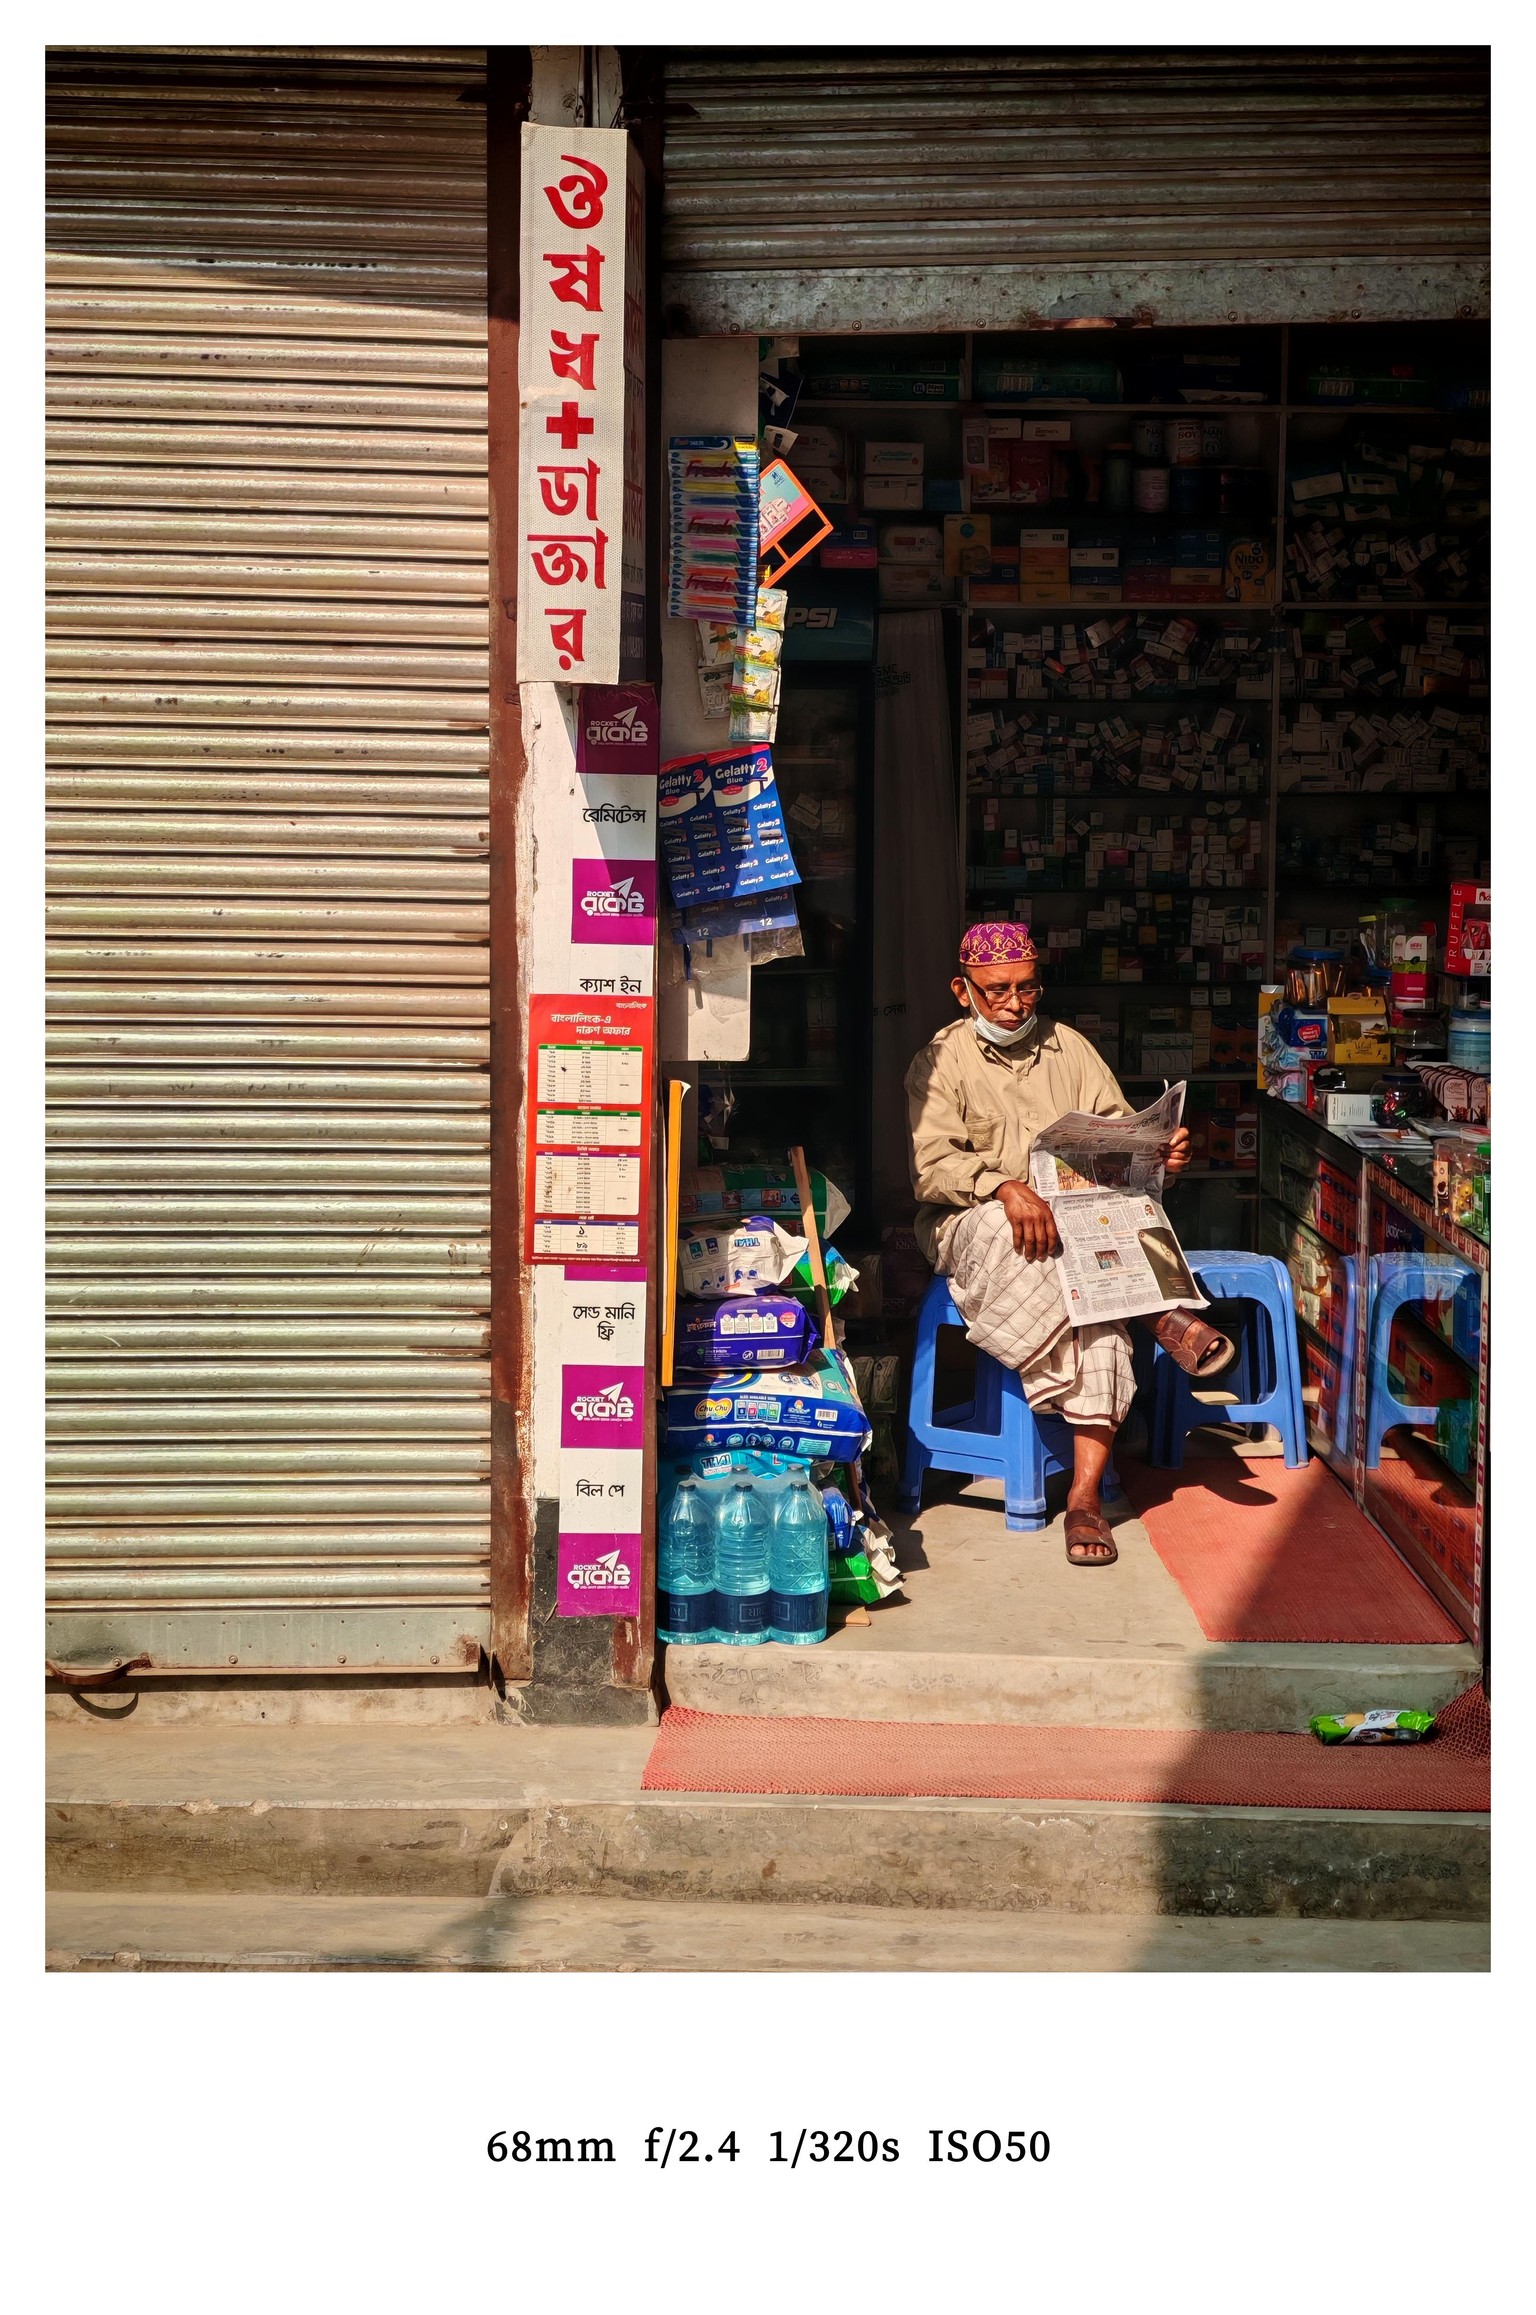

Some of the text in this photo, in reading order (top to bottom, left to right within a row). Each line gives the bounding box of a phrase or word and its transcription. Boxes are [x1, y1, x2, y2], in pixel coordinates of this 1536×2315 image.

[686, 459, 733, 478] Fresh
[687, 517, 732, 535] Fresh
[527, 457, 609, 671] ডাক্তার
[686, 575, 732, 592] Fresh
[786, 607, 838, 629] PSI
[586, 720, 649, 746] রকেট
[582, 803, 646, 824] রেমিটেন্স
[581, 891, 645, 916] রকেট
[760, 917, 772, 927] 12
[1448, 889, 1462, 968] TRUFFLE
[697, 928, 709, 936] 12
[579, 975, 642, 994] ক্যাশ ইন
[551, 1013, 611, 1024] বাংলালিংক-এ
[576, 1026, 632, 1036] দারুণ অফার
[734, 1237, 760, 1247] THAI
[573, 1302, 635, 1320] সেন্ড মানি
[597, 1321, 615, 1341] ফ্রি
[570, 1395, 634, 1421] রকেট
[700, 1454, 732, 1469] THAI
[773, 1455, 782, 1465] L
[576, 1479, 625, 1498] বিল পে
[568, 1564, 630, 1589] রকেট
